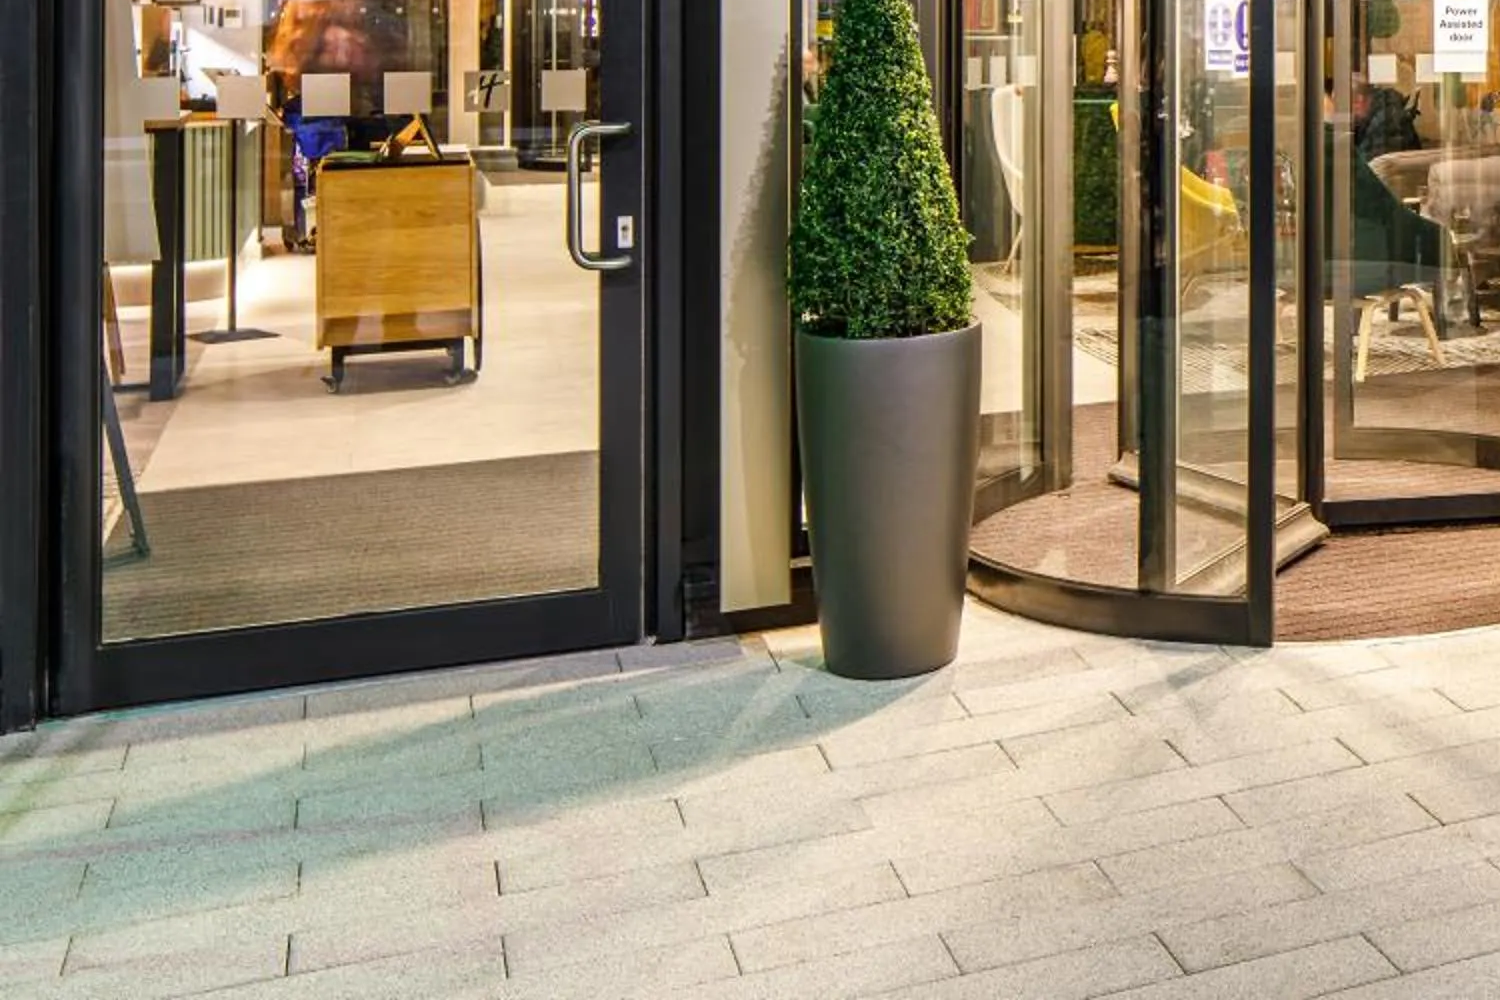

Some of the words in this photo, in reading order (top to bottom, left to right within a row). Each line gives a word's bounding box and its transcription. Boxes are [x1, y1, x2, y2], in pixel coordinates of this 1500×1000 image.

[1445, 5, 1478, 16] Power
[1439, 19, 1483, 29] Assisted
[1449, 32, 1473, 42] door
